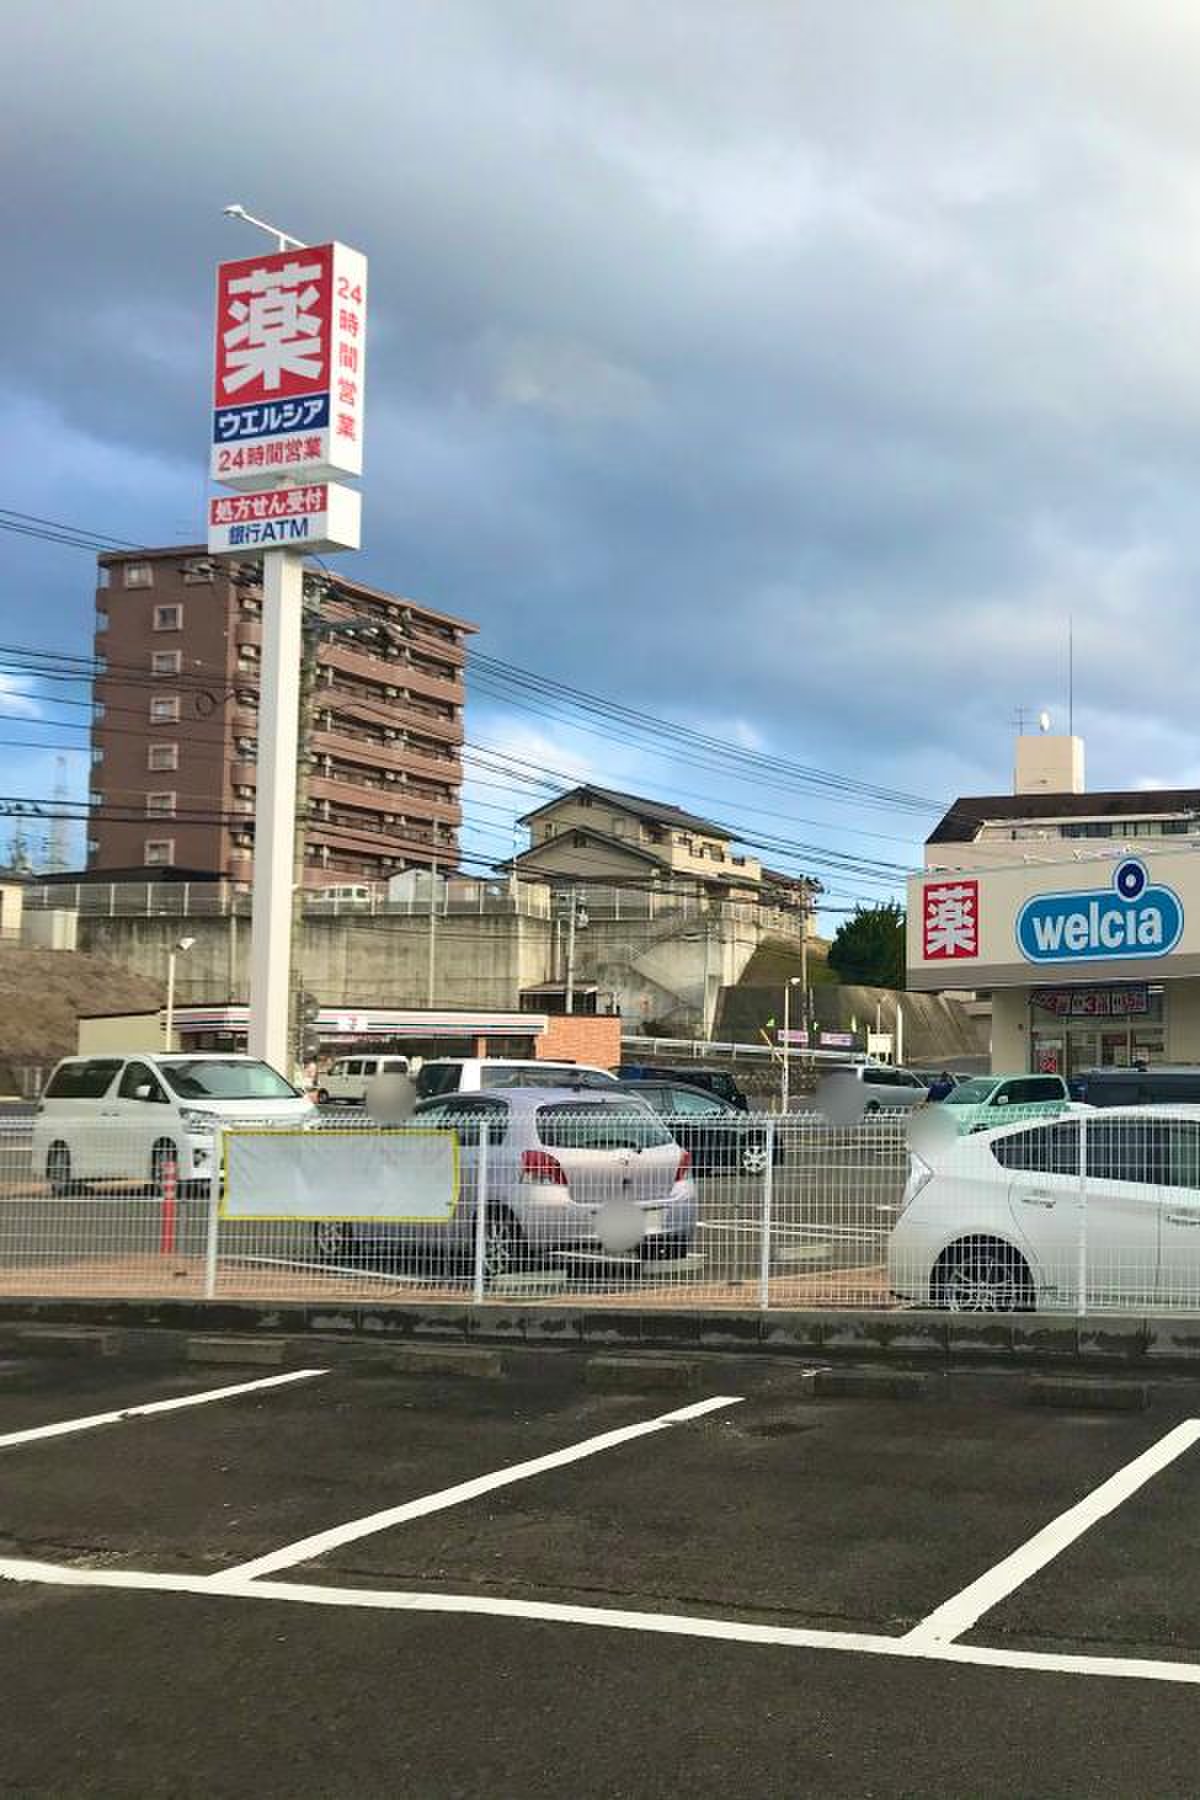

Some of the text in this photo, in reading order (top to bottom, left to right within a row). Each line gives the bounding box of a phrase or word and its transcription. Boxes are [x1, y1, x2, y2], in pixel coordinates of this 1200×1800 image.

[221, 261, 324, 395] 薬
[217, 398, 324, 439] ウエルシア
[217, 436, 323, 472] 24時間営業
[215, 488, 324, 523] 処方せん受付
[228, 517, 309, 546] 銀行ATM
[924, 884, 977, 957] 薬
[1032, 902, 1163, 951] welcia
